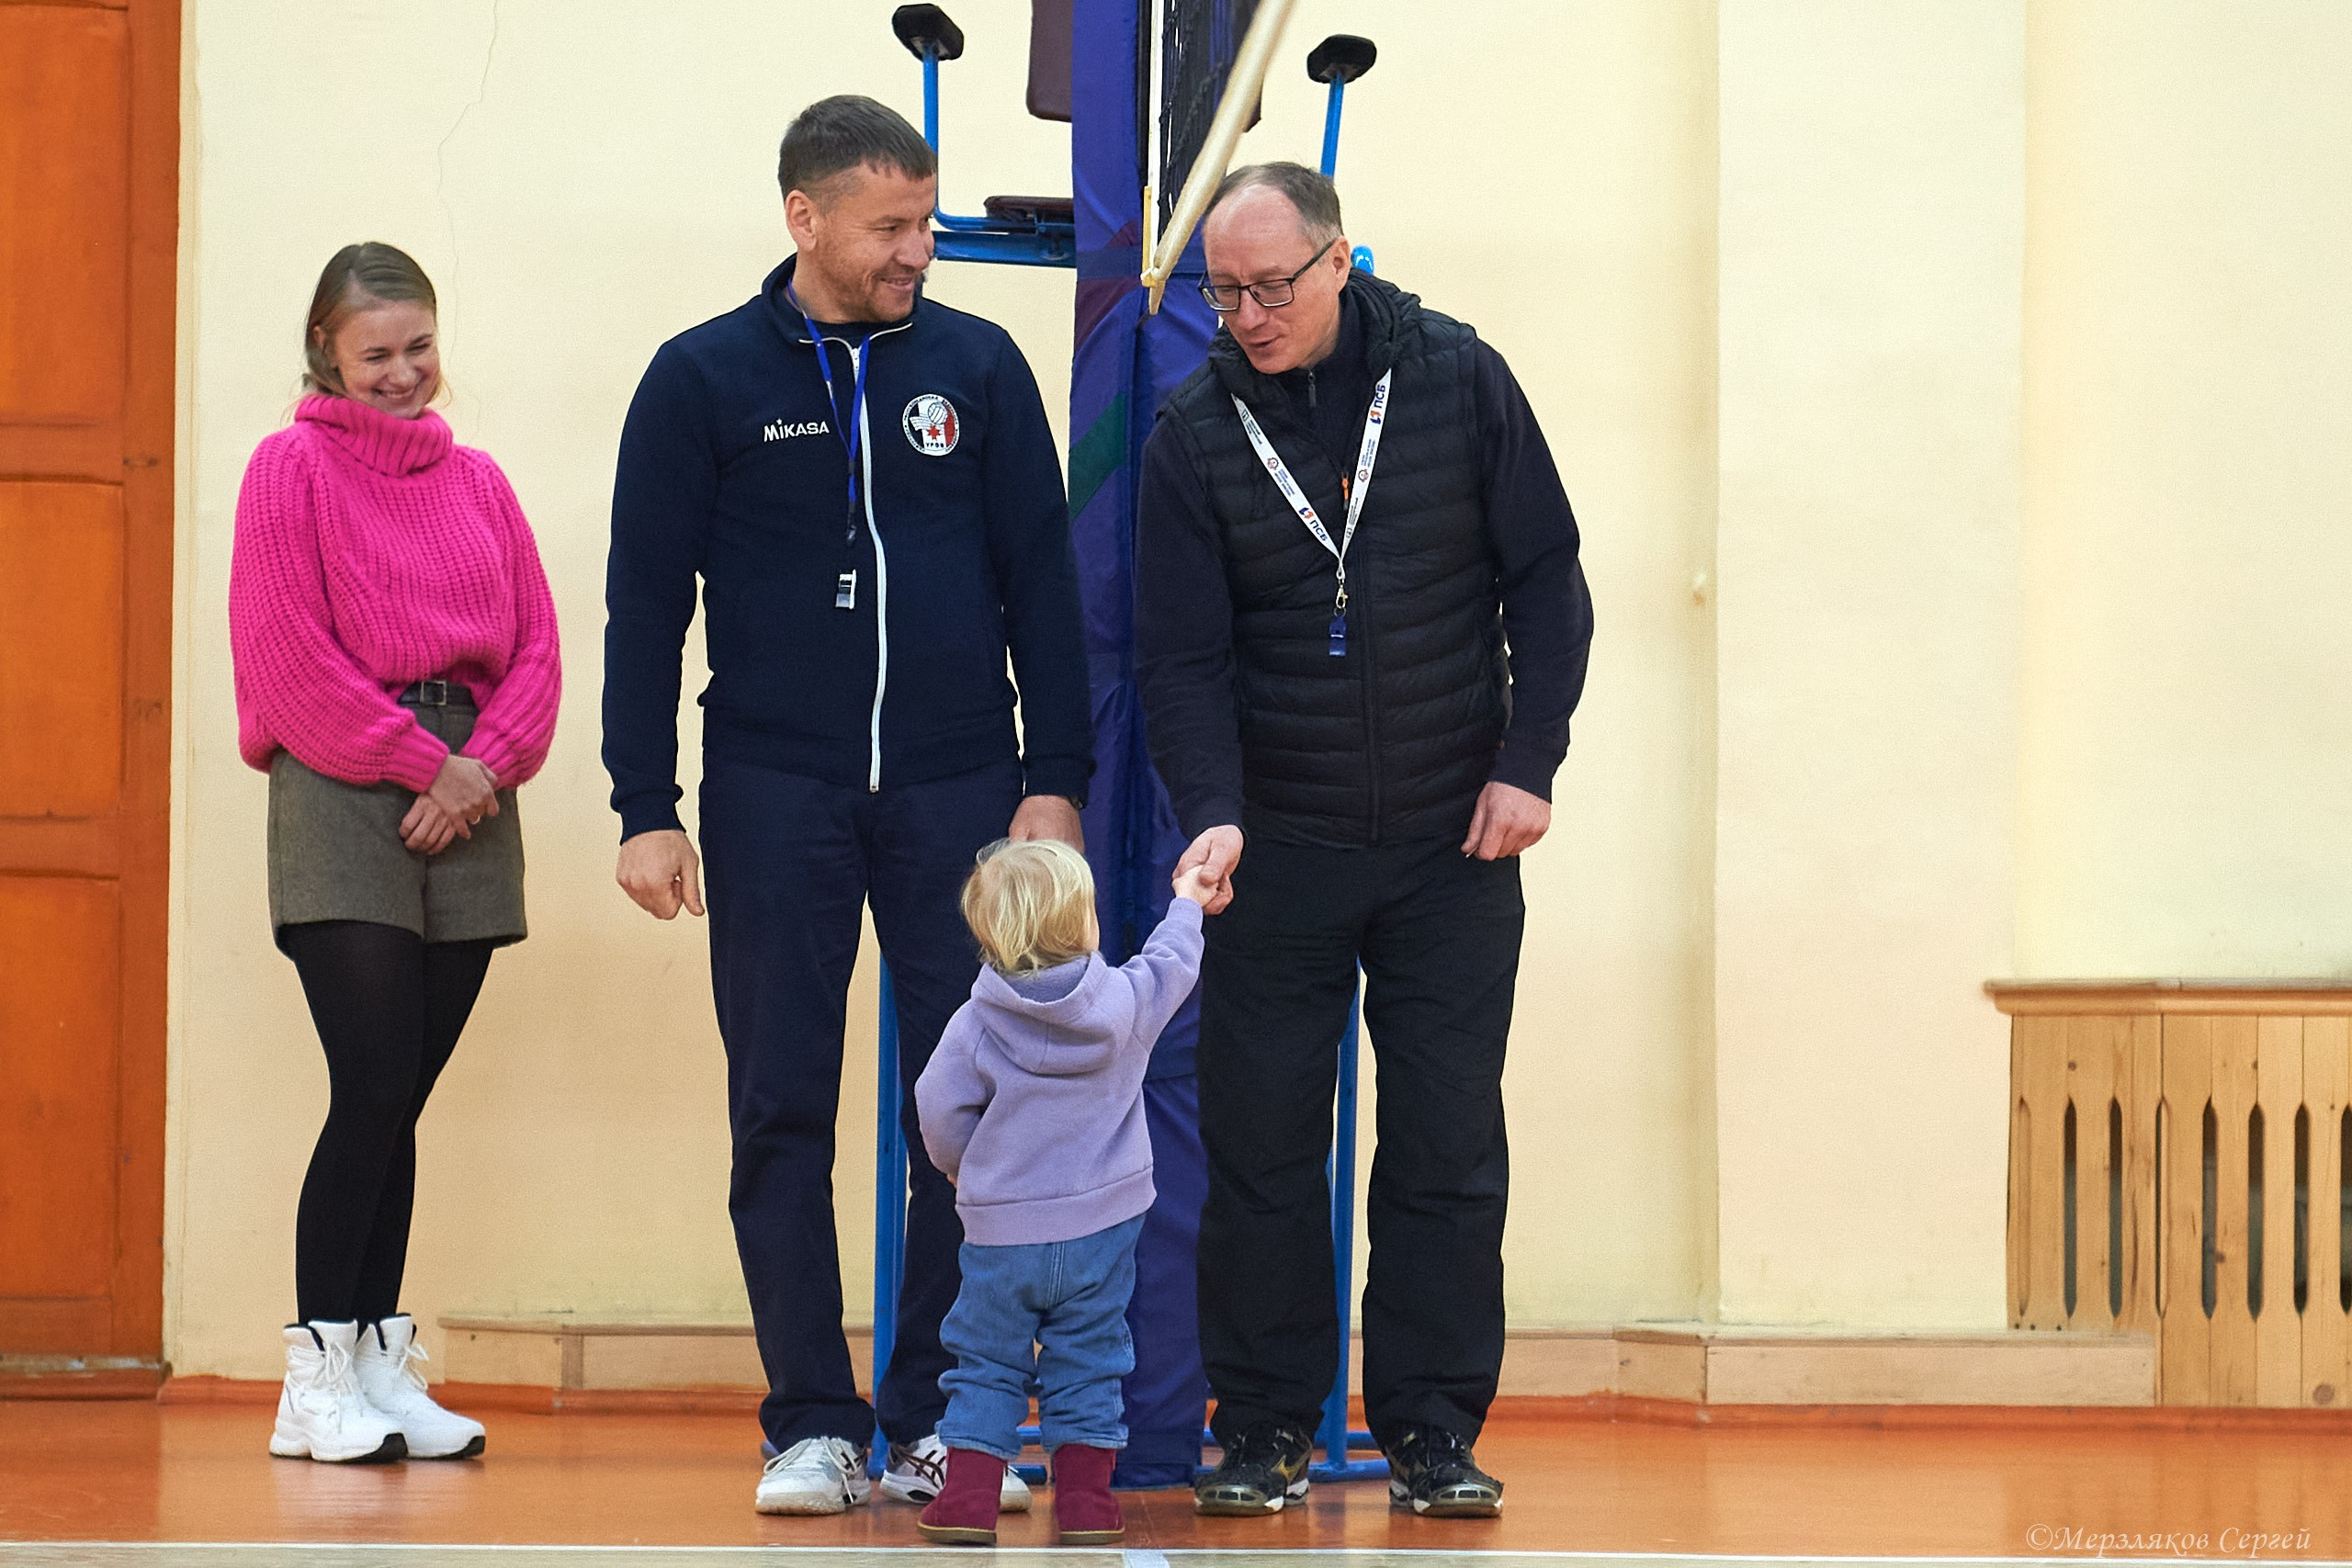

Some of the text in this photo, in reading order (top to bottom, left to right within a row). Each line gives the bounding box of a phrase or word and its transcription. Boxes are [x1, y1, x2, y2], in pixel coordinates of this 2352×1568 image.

[1374, 384, 1385, 409] ПСБ
[763, 418, 830, 442] MIKASA
[1309, 519, 1329, 541] ПСБ
